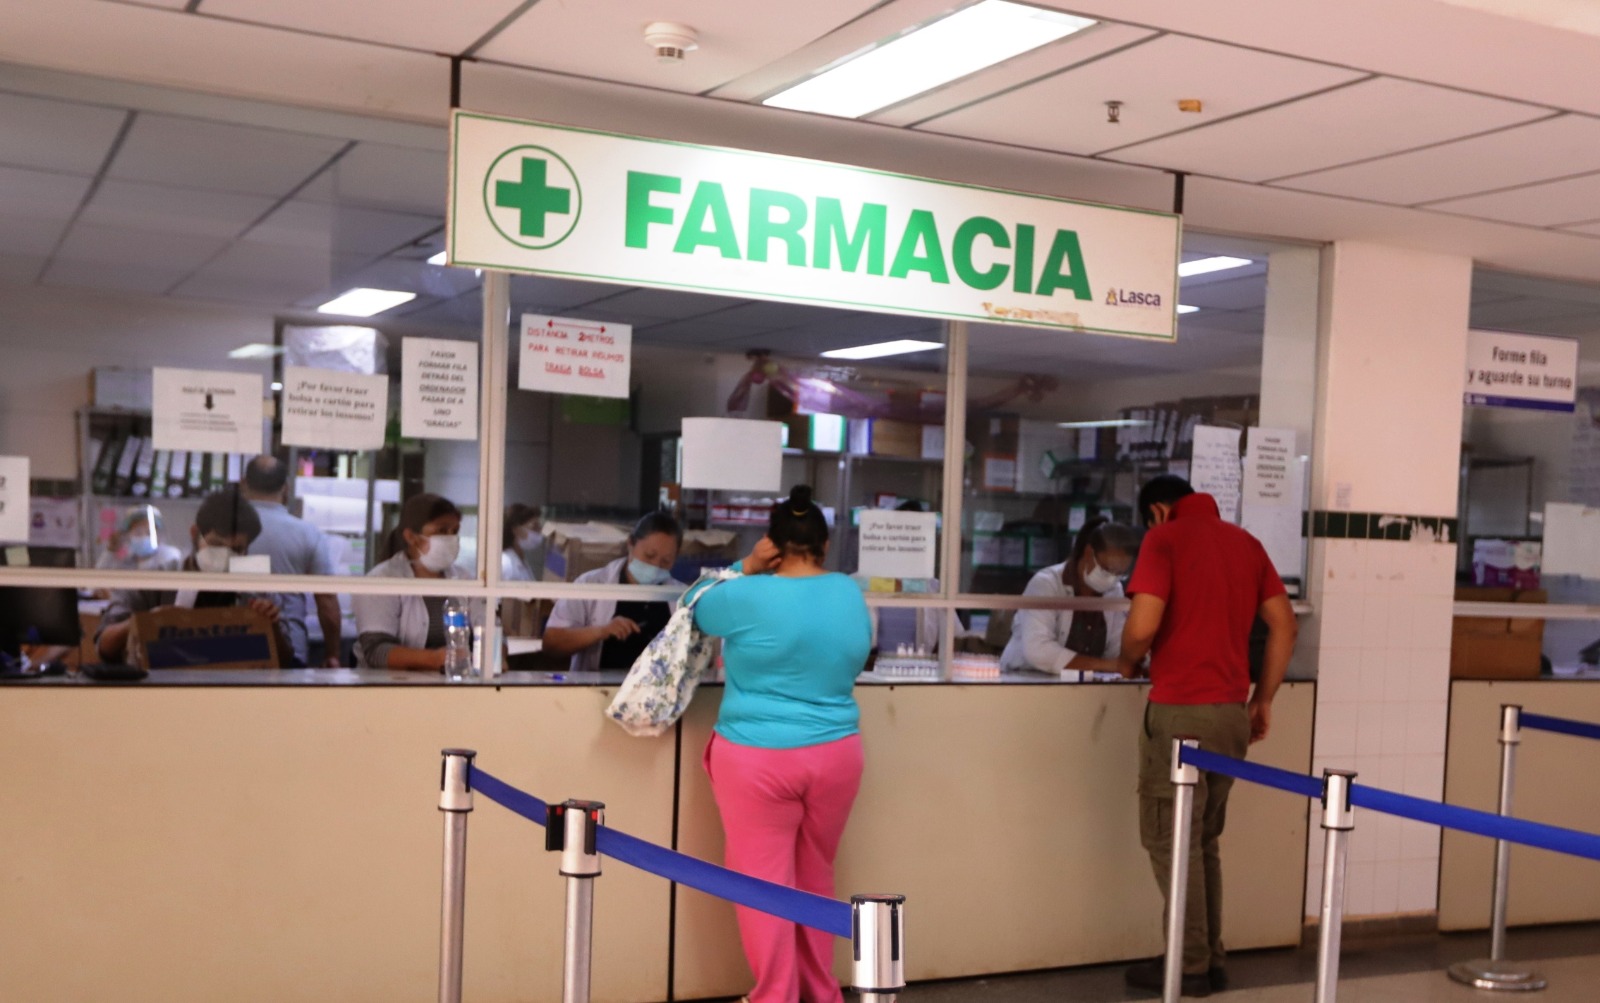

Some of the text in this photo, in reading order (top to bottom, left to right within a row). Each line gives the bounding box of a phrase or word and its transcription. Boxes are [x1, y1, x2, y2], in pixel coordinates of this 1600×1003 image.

[625, 170, 1093, 301] FARMACIA
[1119, 289, 1161, 306] Lasca
[527, 327, 568, 339] DISTANCIA
[431, 350, 456, 359] FAVOR
[528, 342, 624, 362] PARA RETIRAR INSUMOS
[1492, 346, 1547, 365] Forme fila
[418, 360, 467, 371] FORMAR FILA
[578, 365, 605, 378] BOLSA
[451, 374, 464, 382] DEL
[1468, 369, 1572, 389] y aguarde su turno
[320, 383, 342, 393] favor
[346, 386, 368, 395] traer
[419, 384, 466, 394] ORDENADOR
[288, 393, 312, 402] bolsa
[421, 395, 445, 403] PASAR
[288, 408, 374, 420] retirar los insumos!
